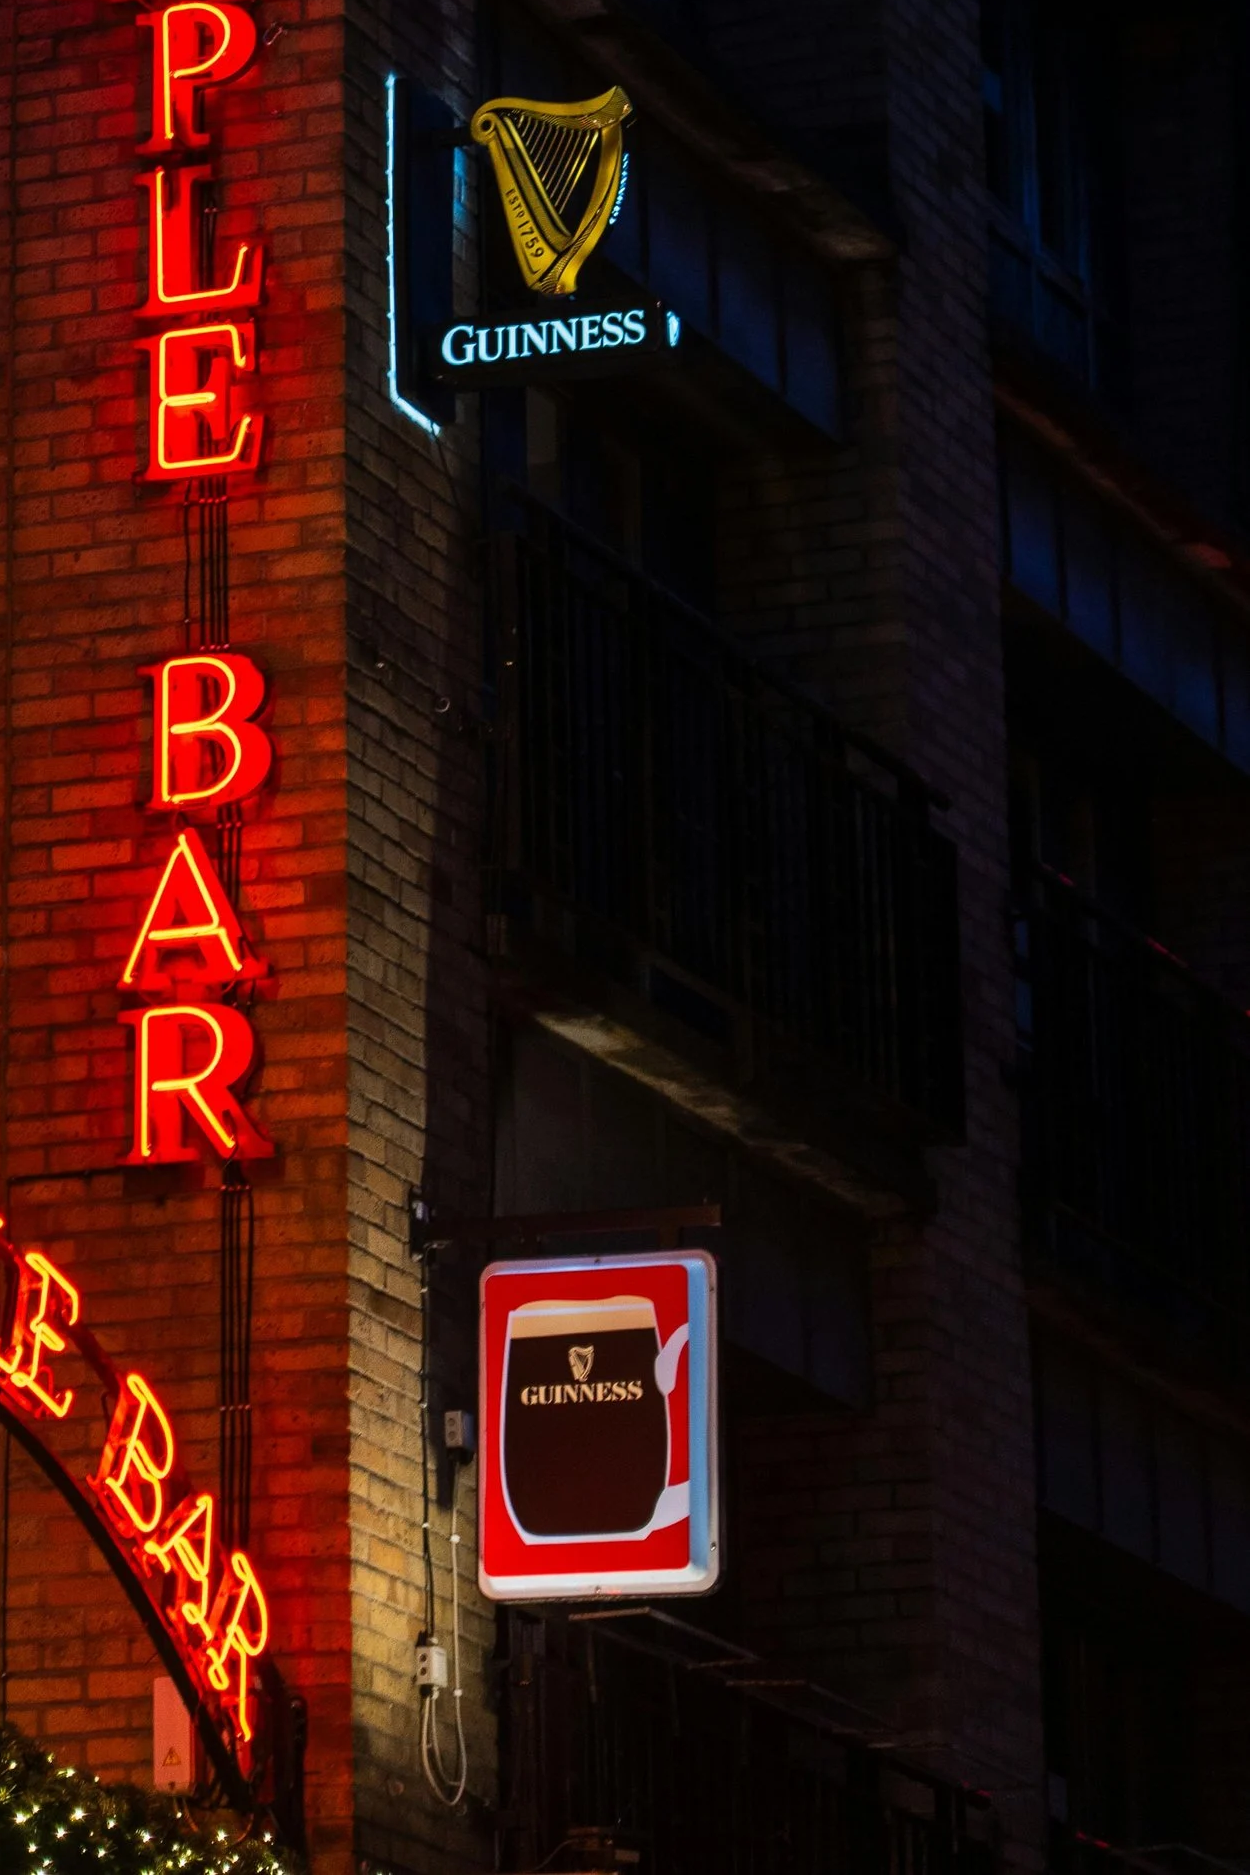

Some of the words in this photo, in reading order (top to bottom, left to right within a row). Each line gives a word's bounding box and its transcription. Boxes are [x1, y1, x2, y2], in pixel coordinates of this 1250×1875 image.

[517, 220, 545, 258] 1759
[442, 310, 645, 365] GUINNESS
[117, 652, 275, 1166] BAR
[520, 1380, 644, 1405] GUINNESS
[88, 1372, 268, 1741] BAR
